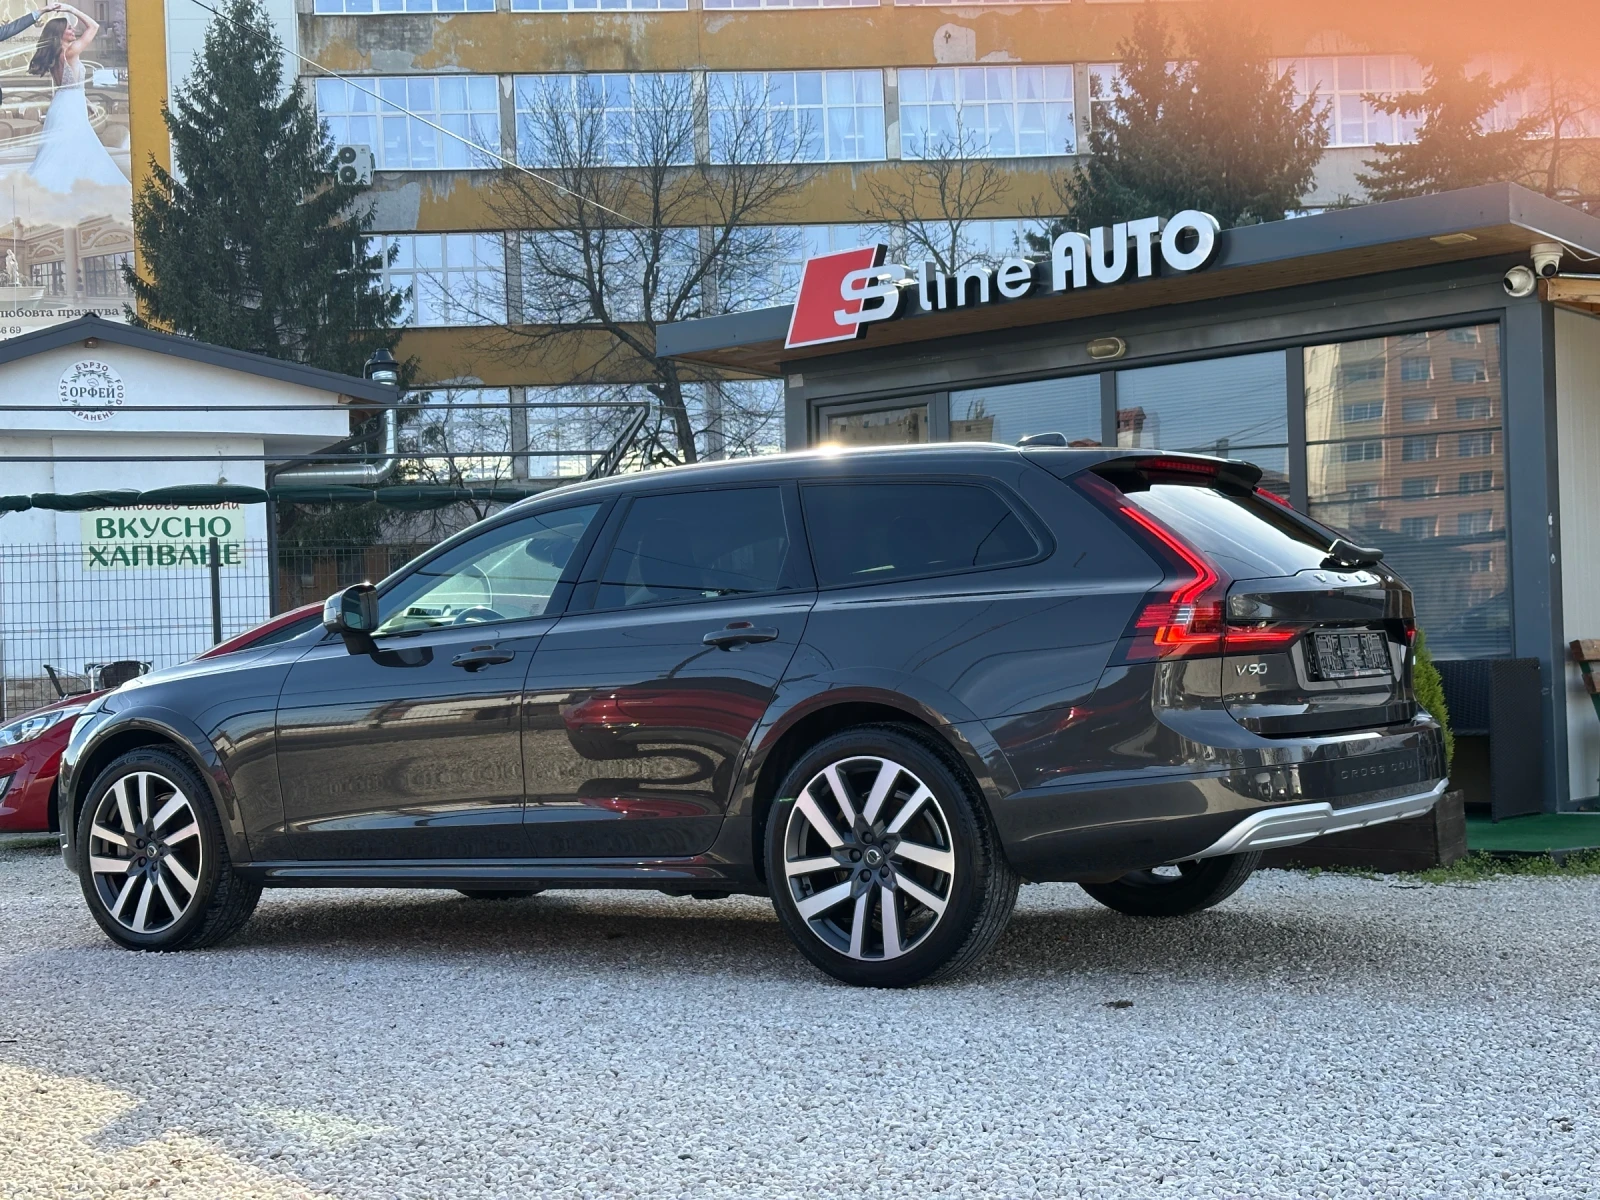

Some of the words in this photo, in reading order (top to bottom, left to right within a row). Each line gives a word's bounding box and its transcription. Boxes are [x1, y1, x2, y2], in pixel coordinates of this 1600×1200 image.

[834, 264, 906, 325] S
[918, 257, 1032, 311] line
[1052, 209, 1217, 291] AUTO
[75, 361, 109, 372] БЪРЗО
[60, 379, 69, 402] FAST
[69, 384, 116, 399] ОРФЕЙ
[115, 379, 124, 405] FOOD
[96, 516, 232, 539] ВКУСНО
[1236, 662, 1268, 676] V90
[1340, 765, 1385, 779] CROSS
